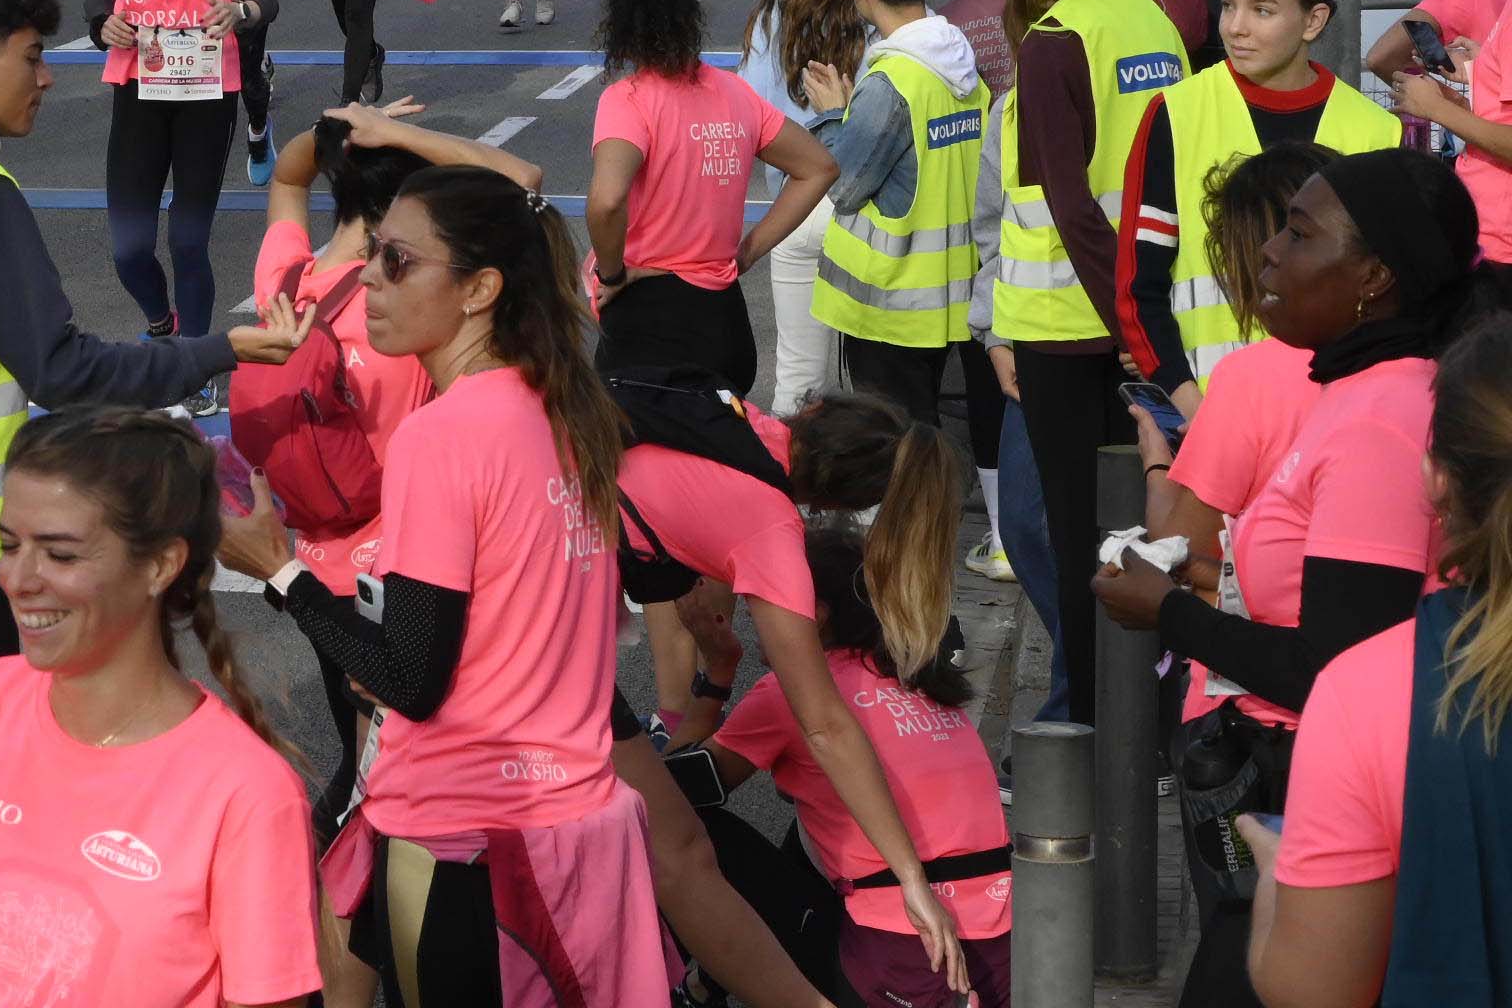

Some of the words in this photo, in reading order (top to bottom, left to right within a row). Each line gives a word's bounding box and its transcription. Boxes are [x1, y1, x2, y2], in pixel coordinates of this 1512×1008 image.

[130, 10, 201, 27] DORSAL
[167, 55, 195, 66] 016
[1120, 61, 1183, 85] VOLUTA
[690, 122, 746, 141] CARRERA
[929, 117, 981, 142] VOLUTARIS
[703, 140, 721, 158] DE
[723, 140, 738, 157] LA
[701, 158, 742, 177] MUJER
[886, 702, 919, 719] DE
[895, 710, 967, 737] MUJER
[501, 760, 567, 782] OYSHO
[85, 839, 154, 878] ASTURIANA
